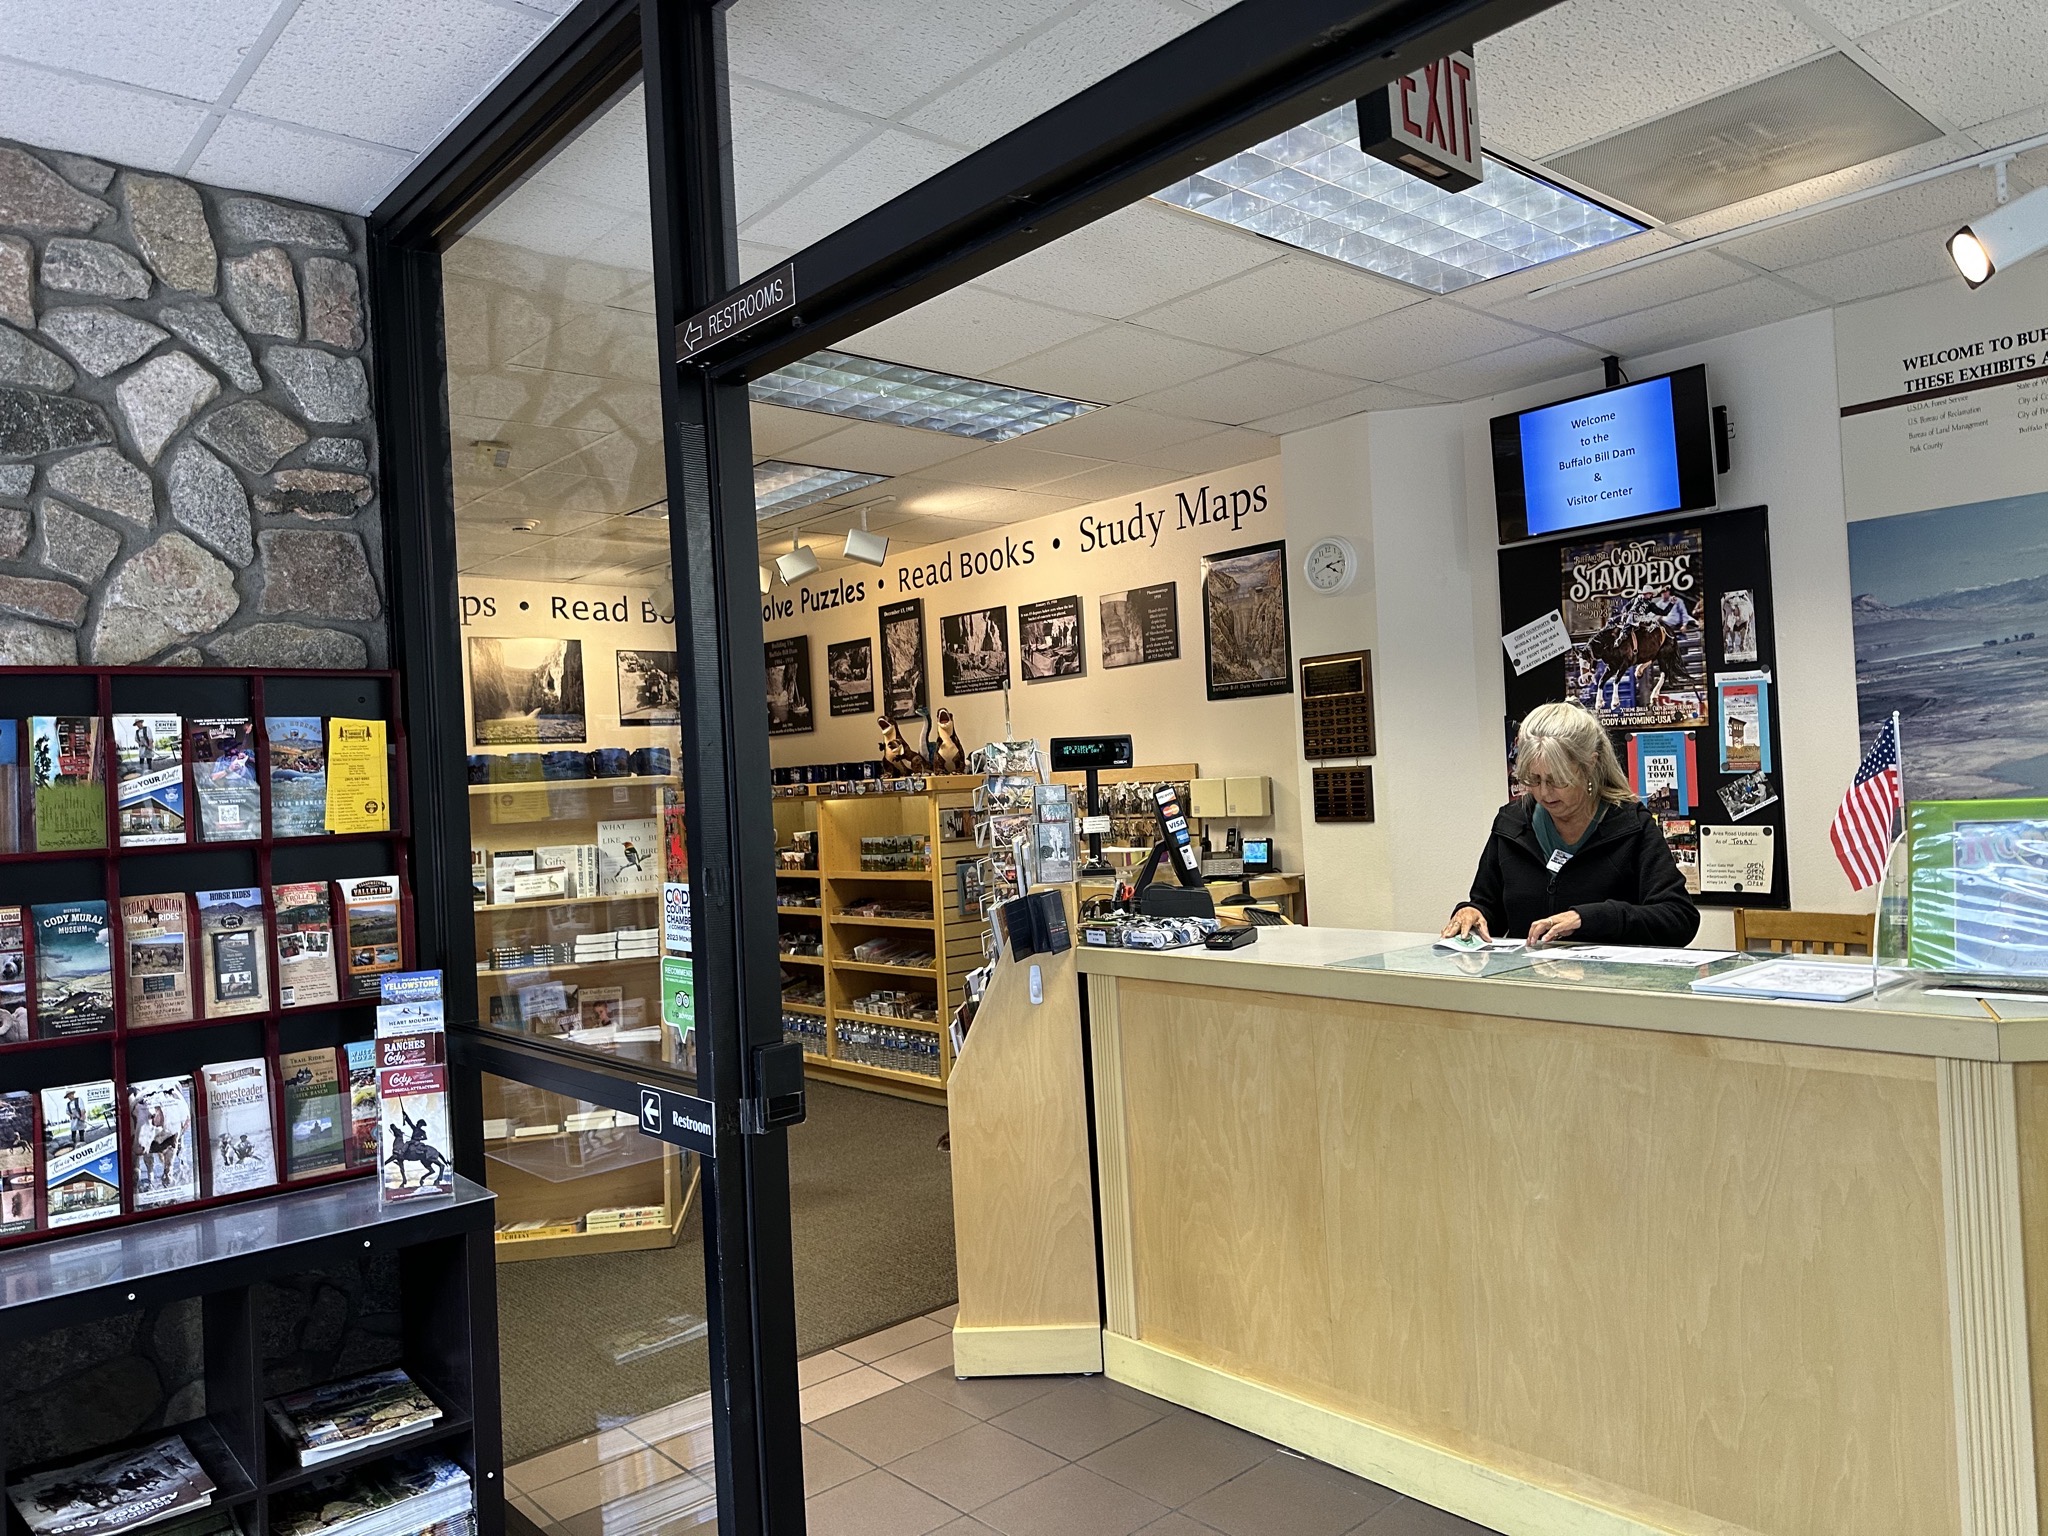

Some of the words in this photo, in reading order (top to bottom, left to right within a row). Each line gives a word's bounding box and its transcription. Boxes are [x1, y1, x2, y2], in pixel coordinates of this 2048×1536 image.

[1401, 56, 1472, 163] EXIT
[708, 279, 784, 336] RESTROOMS
[1902, 342, 1985, 371] WELCOME
[1989, 336, 2013, 353] TO
[1904, 371, 1954, 393] THESE
[1958, 354, 2036, 381] EXHIBITS
[2018, 395, 2030, 405] City
[2032, 394, 2039, 402] of
[1920, 415, 1938, 424] Bureau
[1947, 407, 1981, 419] Reclamation
[2018, 410, 2030, 419] City
[2032, 408, 2039, 416] of
[1570, 411, 1616, 430] Welcome
[1908, 431, 1927, 440] Bureau
[1936, 426, 1950, 435] Land
[1951, 419, 1989, 433] Management
[2019, 425, 2043, 434] Buffalo
[1580, 437, 1591, 447] to
[1593, 432, 1609, 444] the
[1909, 445, 1921, 453] Park
[1923, 441, 1943, 451] County
[1558, 456, 1592, 471] Buffalo
[1594, 451, 1610, 463] Bill
[1612, 446, 1636, 459] Dam
[1593, 472, 1602, 482] &
[1566, 493, 1598, 507] Visitor
[1600, 486, 1633, 501] Center
[763, 595, 794, 622] olve
[801, 578, 866, 614] Puzzles
[898, 555, 953, 593] Read
[960, 535, 1035, 580] Books
[1079, 501, 1165, 552] Study
[1176, 485, 1269, 531] Maps
[1611, 541, 1656, 567] CODY
[1570, 555, 1694, 602] STAMPEDE
[551, 595, 629, 622] Read
[1588, 608, 1608, 619] 2023
[1601, 717, 1619, 726] CODY
[1620, 716, 1656, 726] WYOMING
[1657, 715, 1672, 724] USA
[1647, 771, 1675, 779] TOWN
[137, 776, 160, 788] YOUR
[601, 823, 626, 831] WHAT
[1168, 819, 1185, 829] VISA
[1731, 837, 1753, 845] TODAY
[544, 856, 567, 867] Gifts
[1746, 861, 1764, 869] OPEN
[603, 876, 629, 884] DAVID
[209, 892, 231, 901] HORSE
[231, 890, 251, 899] RIDES
[285, 893, 314, 901] TROLLEY
[353, 887, 379, 896] VALLEY
[124, 900, 145, 917] CEDAR
[148, 898, 183, 913] MOUNTAIN
[1, 913, 20, 921] LODGE
[43, 914, 69, 928] CODY
[71, 913, 104, 925] MURAL
[129, 915, 148, 924] TRAIL
[158, 912, 180, 921] RIDES
[58, 925, 88, 934] MUSEUM
[384, 980, 439, 991] YELLOWSTONE
[409, 1016, 439, 1024] MOUNTAIN
[384, 1039, 425, 1053] RANCHES
[308, 1054, 325, 1062] RIDES
[384, 1051, 406, 1065] Cody
[389, 1072, 413, 1087] Cody
[210, 1084, 264, 1103] Homesteader
[310, 1088, 328, 1096] RANCH
[211, 1094, 264, 1107] MUSEUM
[672, 1110, 711, 1136] Restroom
[69, 1148, 94, 1162] YOUR
[51, 1519, 99, 1534] cody
[104, 1490, 180, 1521] country
